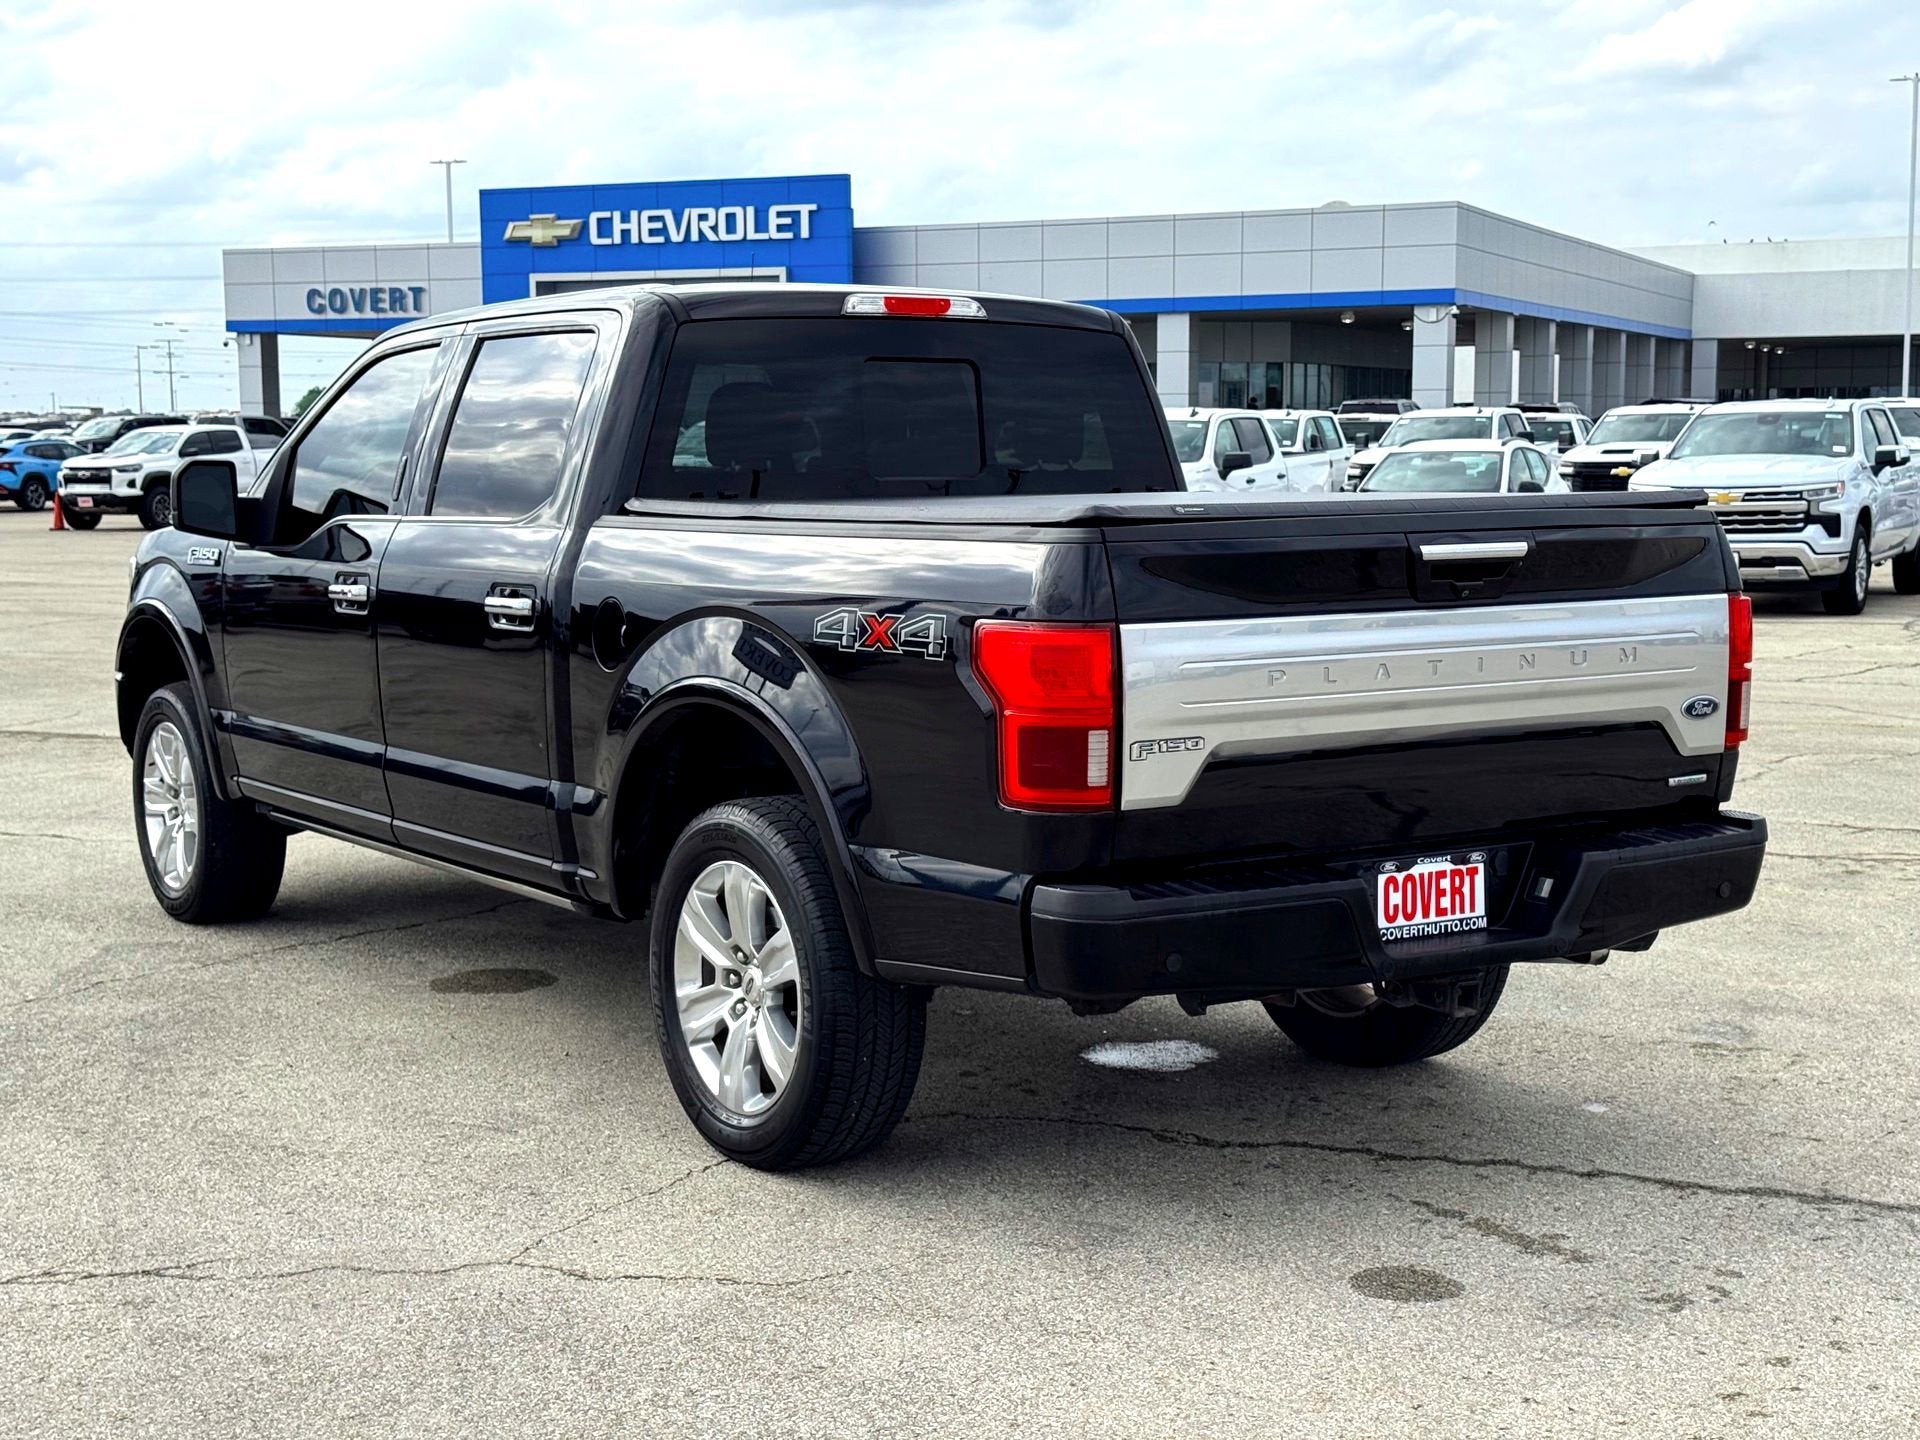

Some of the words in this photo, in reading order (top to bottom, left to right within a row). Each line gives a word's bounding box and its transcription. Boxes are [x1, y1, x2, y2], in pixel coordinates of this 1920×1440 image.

[589, 203, 817, 246] CHEVROLET
[306, 287, 426, 314] COVERT
[1267, 646, 1637, 687] PLATINUM
[1417, 855, 1452, 864] Covert
[1383, 866, 1479, 925] COVERT
[1380, 916, 1488, 941] COVERTHUTTO.COM
